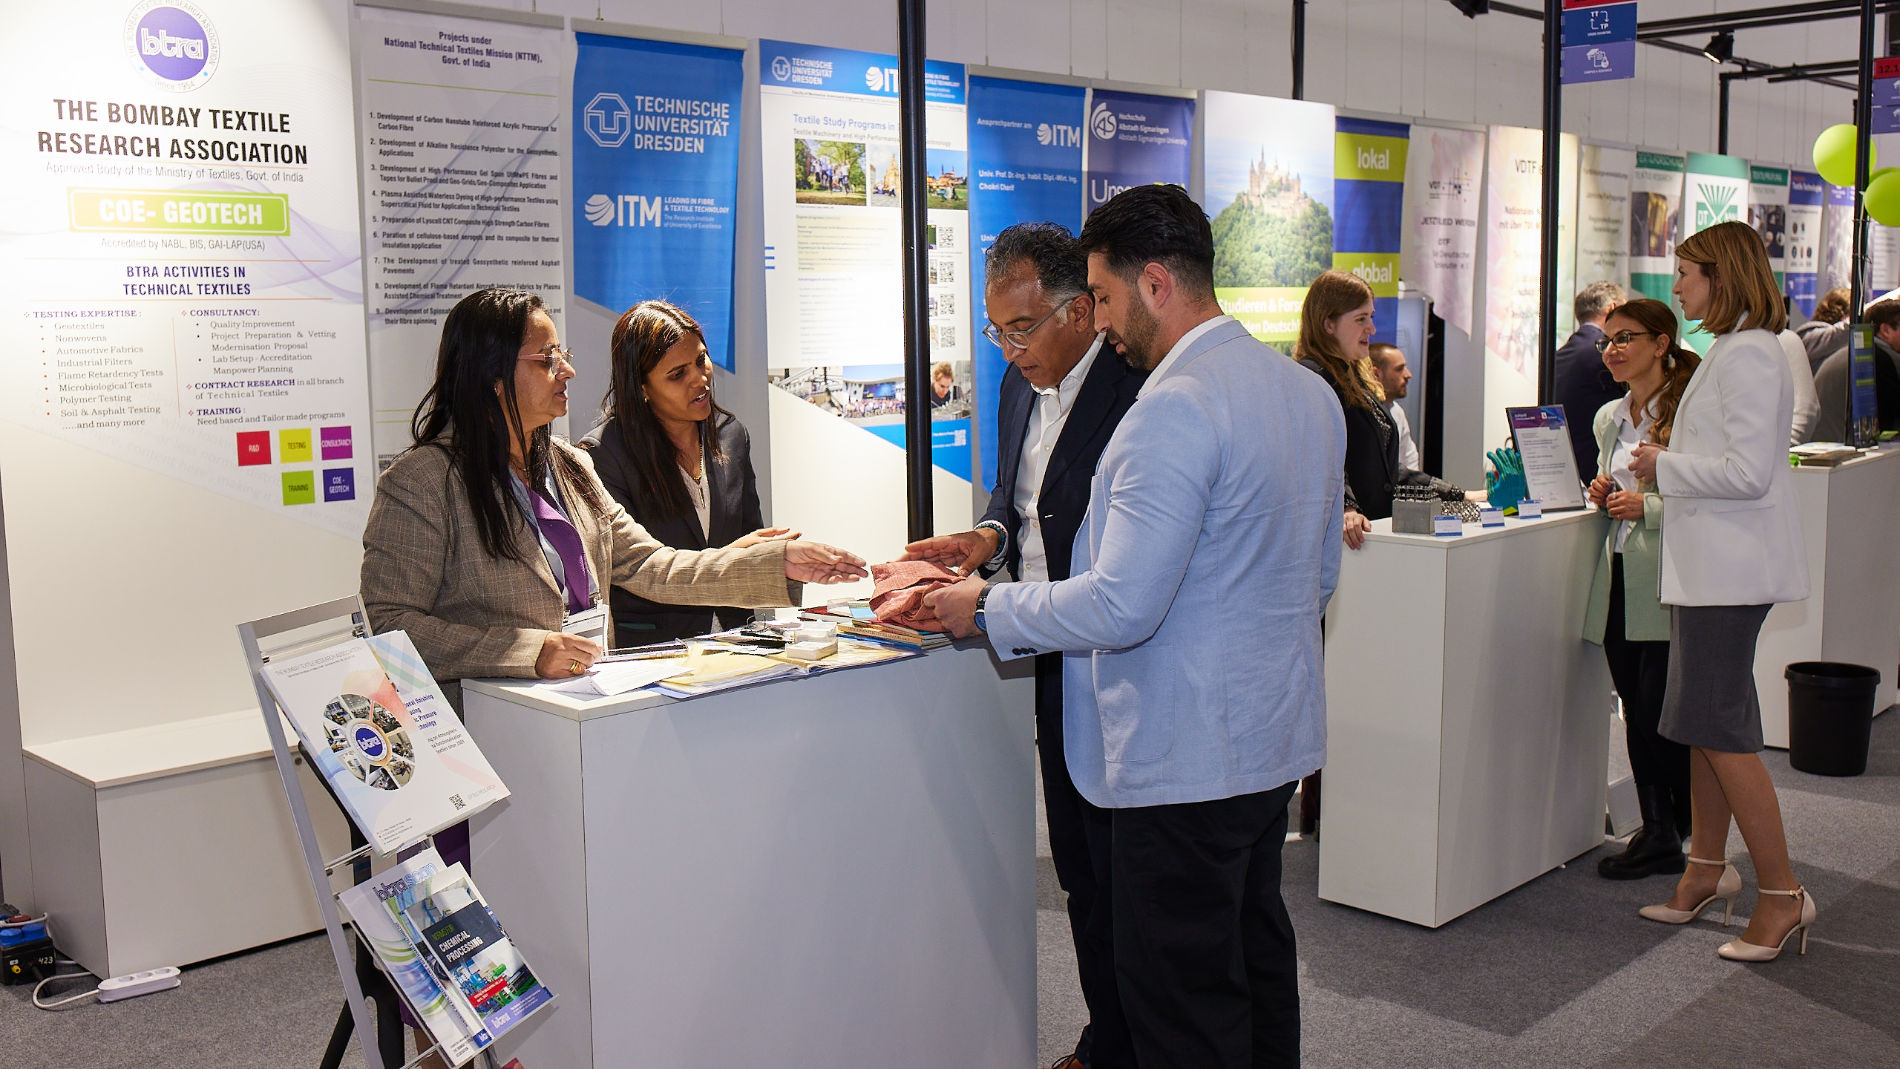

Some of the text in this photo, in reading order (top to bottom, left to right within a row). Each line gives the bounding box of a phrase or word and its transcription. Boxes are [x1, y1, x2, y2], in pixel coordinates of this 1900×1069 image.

[140, 28, 204, 60] btra
[438, 32, 492, 45] Projects under
[384, 37, 417, 49] National
[419, 40, 455, 52] Technical
[457, 45, 484, 56] Textiles
[486, 49, 513, 59] Mission
[442, 56, 491, 68] Govt. of India
[792, 58, 833, 70] TECHNISCHE
[884, 68, 899, 94] IT
[634, 95, 730, 118] TECHNISCHE
[53, 98, 291, 134] THE BOMBAY TEXTILE
[793, 113, 821, 126] Textile
[823, 116, 847, 129] Study
[848, 118, 887, 131] Programs
[634, 114, 730, 136] UNIVERSITÄT
[1052, 124, 1080, 148] ITM
[38, 131, 308, 165] RESEARCH ASSOCIATION
[634, 133, 704, 154] DRESDEN
[1357, 147, 1390, 170] lokal
[137, 166, 152, 176] the
[155, 166, 192, 180] Ministry
[196, 168, 206, 178] of
[272, 171, 281, 182] of
[282, 172, 304, 182] India
[164, 201, 263, 226] GEOTECH
[617, 194, 662, 228] ITM
[149, 238, 159, 250] by
[208, 240, 266, 252] GAI-LAP(USA)
[126, 265, 246, 278] BTRA ACTIVITIES IN
[123, 283, 251, 296] TECHNICAL TEXTILES
[54, 322, 105, 330] Geotextiles
[210, 320, 296, 329] Quality Improvement
[55, 335, 107, 343] Nonwovens
[210, 332, 239, 341] Project
[245, 331, 292, 340] Preparation
[308, 330, 336, 339] Vetting
[56, 346, 144, 356] Automotive Fabrics
[212, 342, 308, 352] Modernisation Proposal
[57, 358, 133, 367] Industrial Filters
[212, 353, 312, 364] Lab Setup Accreditation
[58, 368, 164, 380] Flame Retardency Tests
[213, 365, 294, 376] Manpower Planning
[59, 381, 152, 393] Microbiological Tests
[195, 377, 344, 390] CONTRACT RESEARCH in all branch
[60, 394, 132, 405] Polymer Testing
[195, 389, 289, 400] of Technical Textiles
[61, 408, 78, 417] Soil
[91, 406, 126, 417] Asphalt
[127, 405, 161, 414] Testing
[96, 419, 121, 429] many
[197, 412, 345, 426] Need based and Tailor made programs
[438, 930, 471, 952] CHEMICAL
[446, 936, 484, 962] PROCESSING
